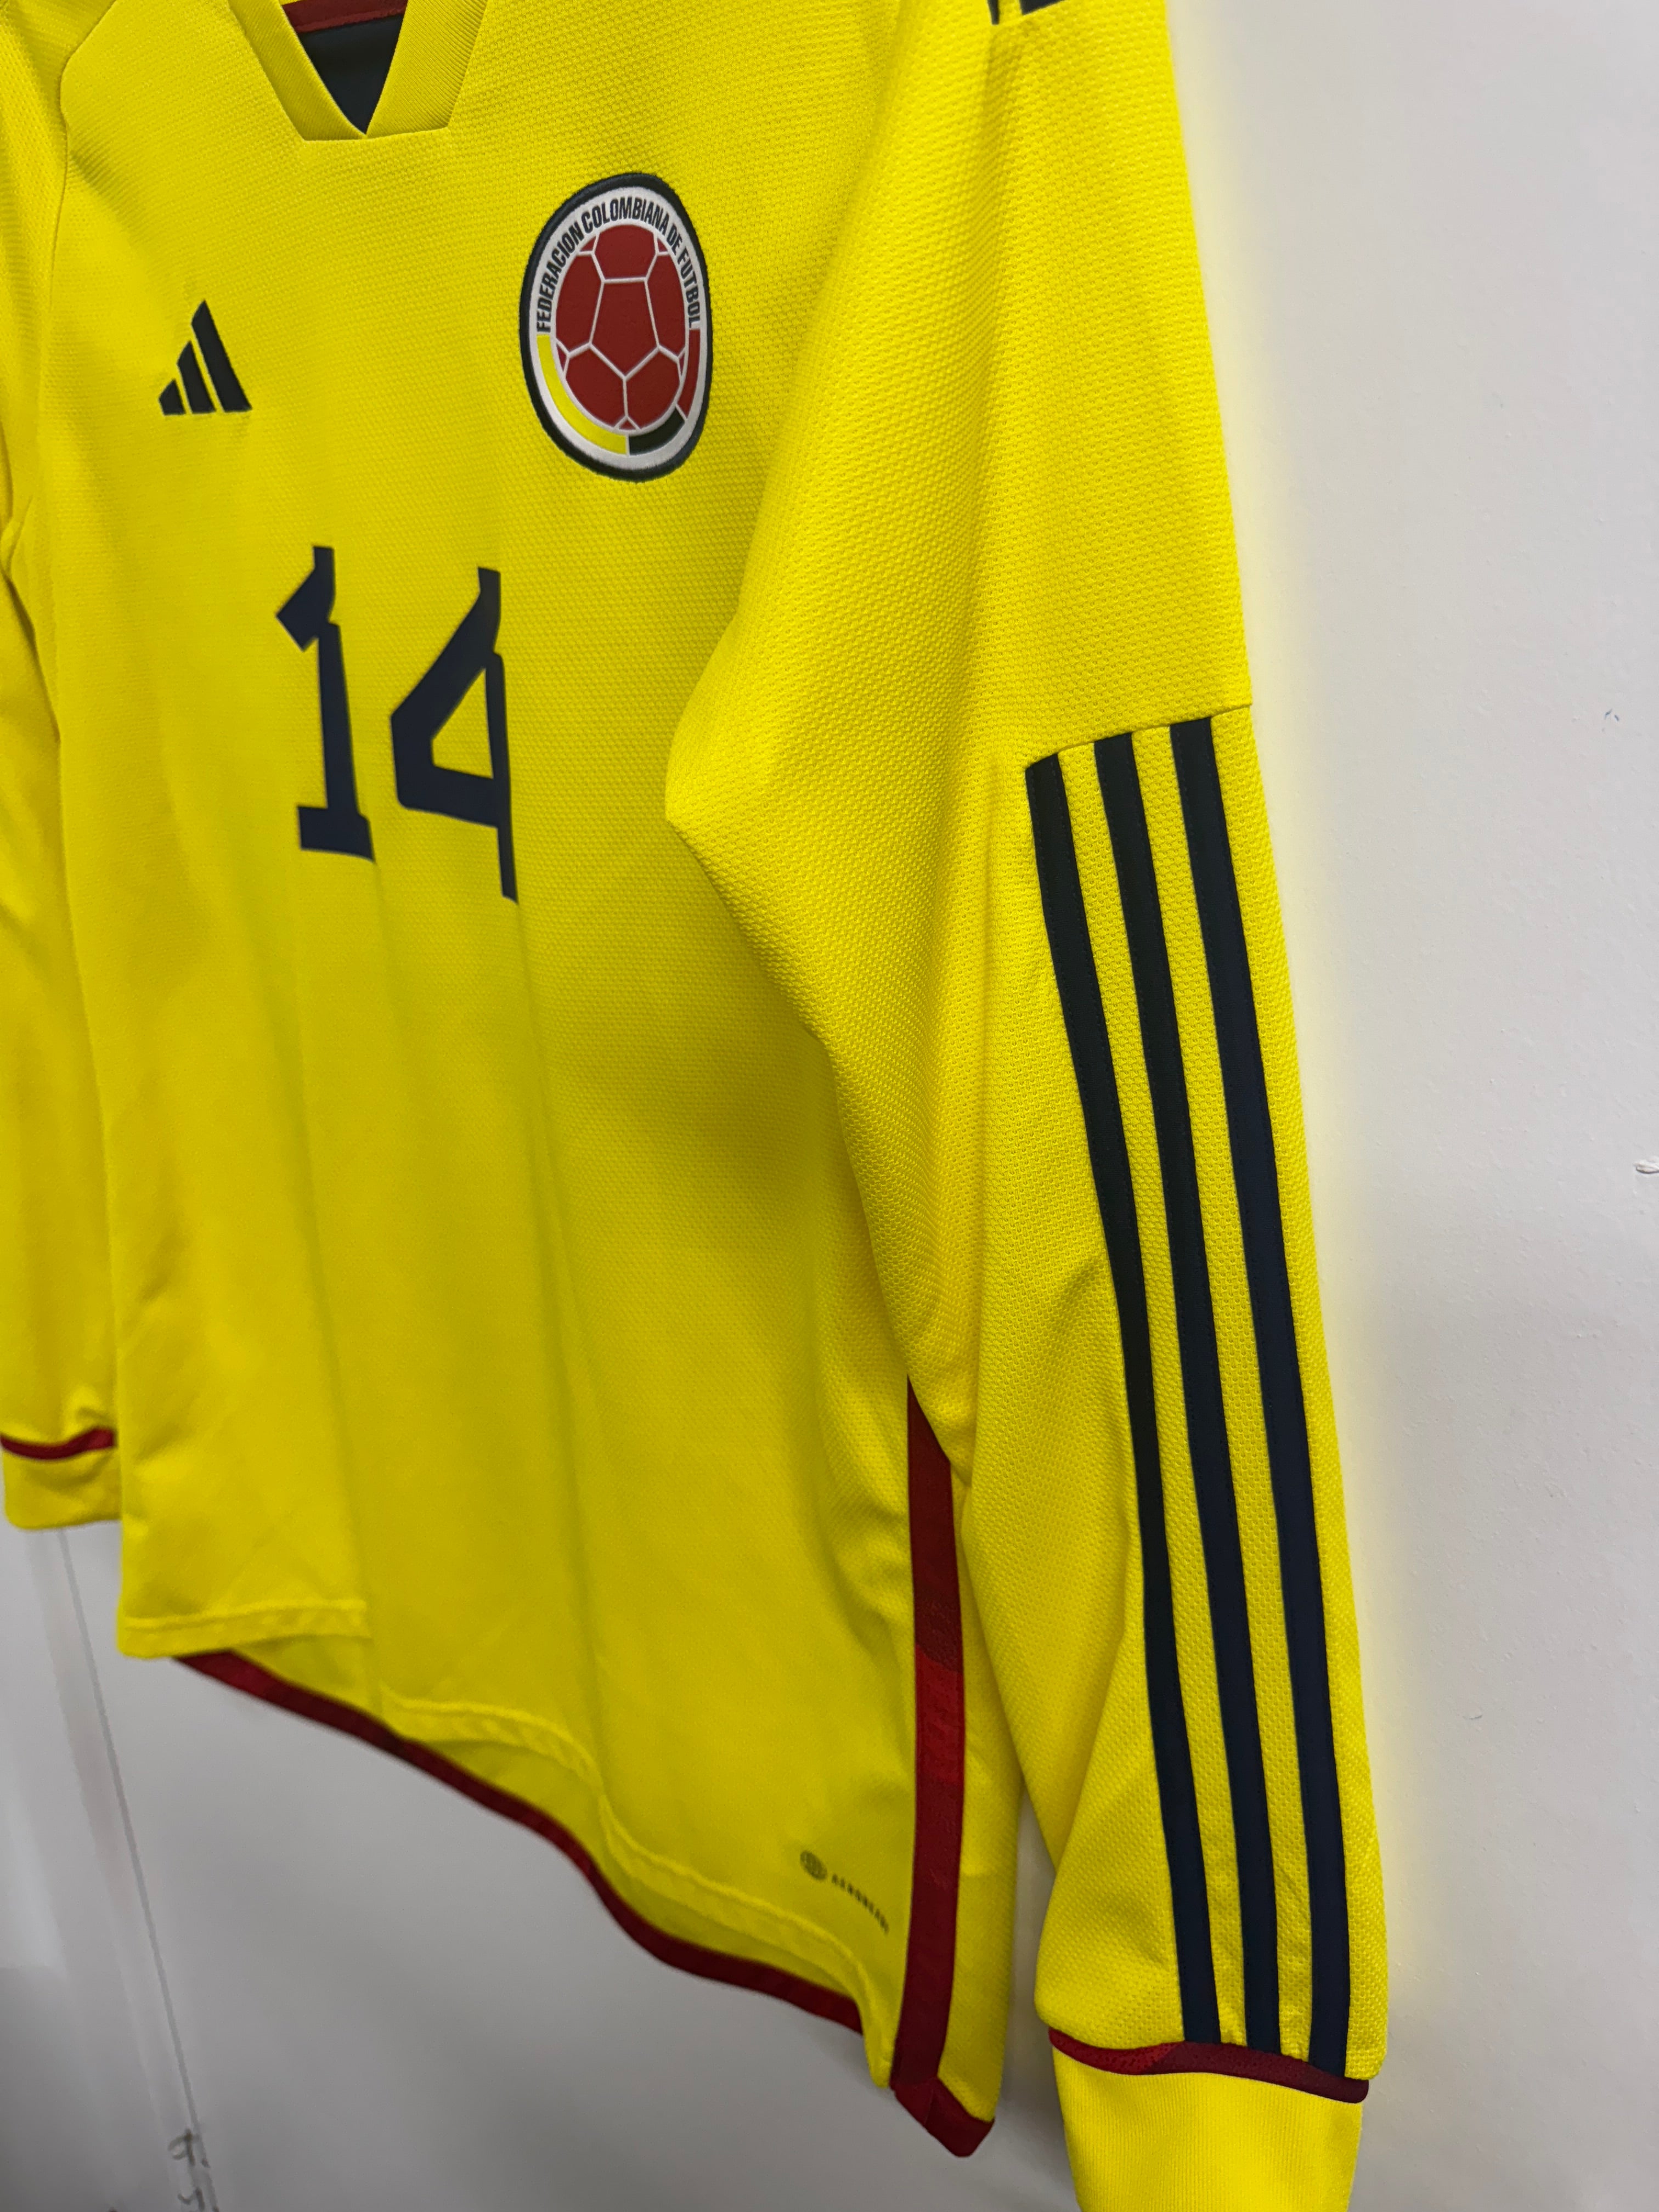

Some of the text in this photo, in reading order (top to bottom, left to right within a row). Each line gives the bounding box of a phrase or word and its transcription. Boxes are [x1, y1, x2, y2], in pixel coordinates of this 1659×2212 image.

[537, 196, 701, 332] FEDERACION COLOMBIANA DE FUTBOL
[276, 545, 518, 905] 14
